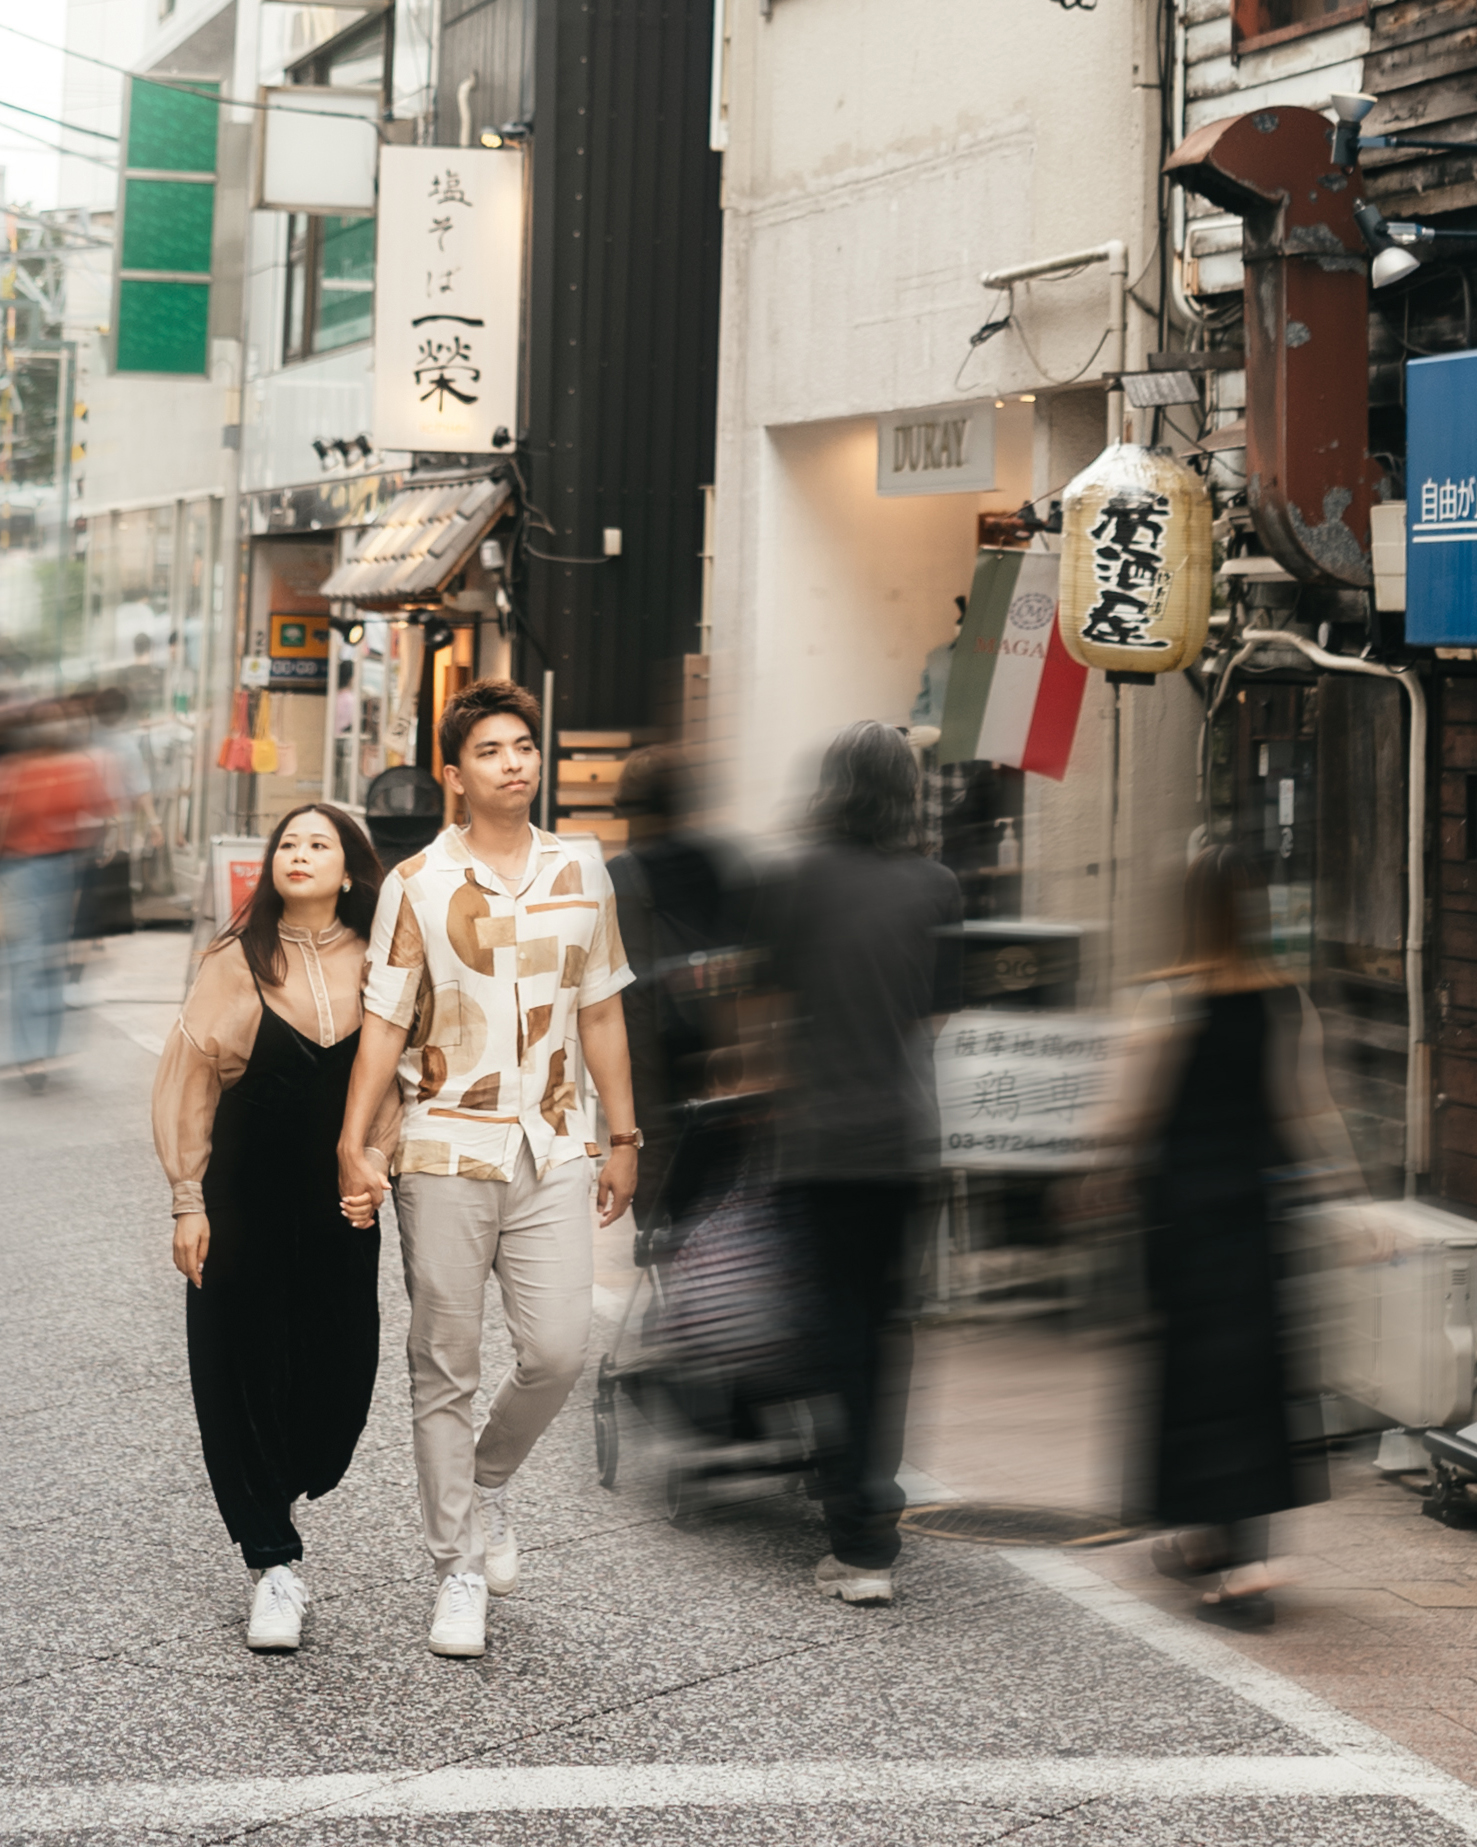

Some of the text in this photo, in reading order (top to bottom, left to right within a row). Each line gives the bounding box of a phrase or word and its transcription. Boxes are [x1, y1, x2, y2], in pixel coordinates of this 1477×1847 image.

[427, 168, 473, 298] 塩そば
[892, 418, 968, 473] DURAY
[1422, 476, 1477, 522] 自由が
